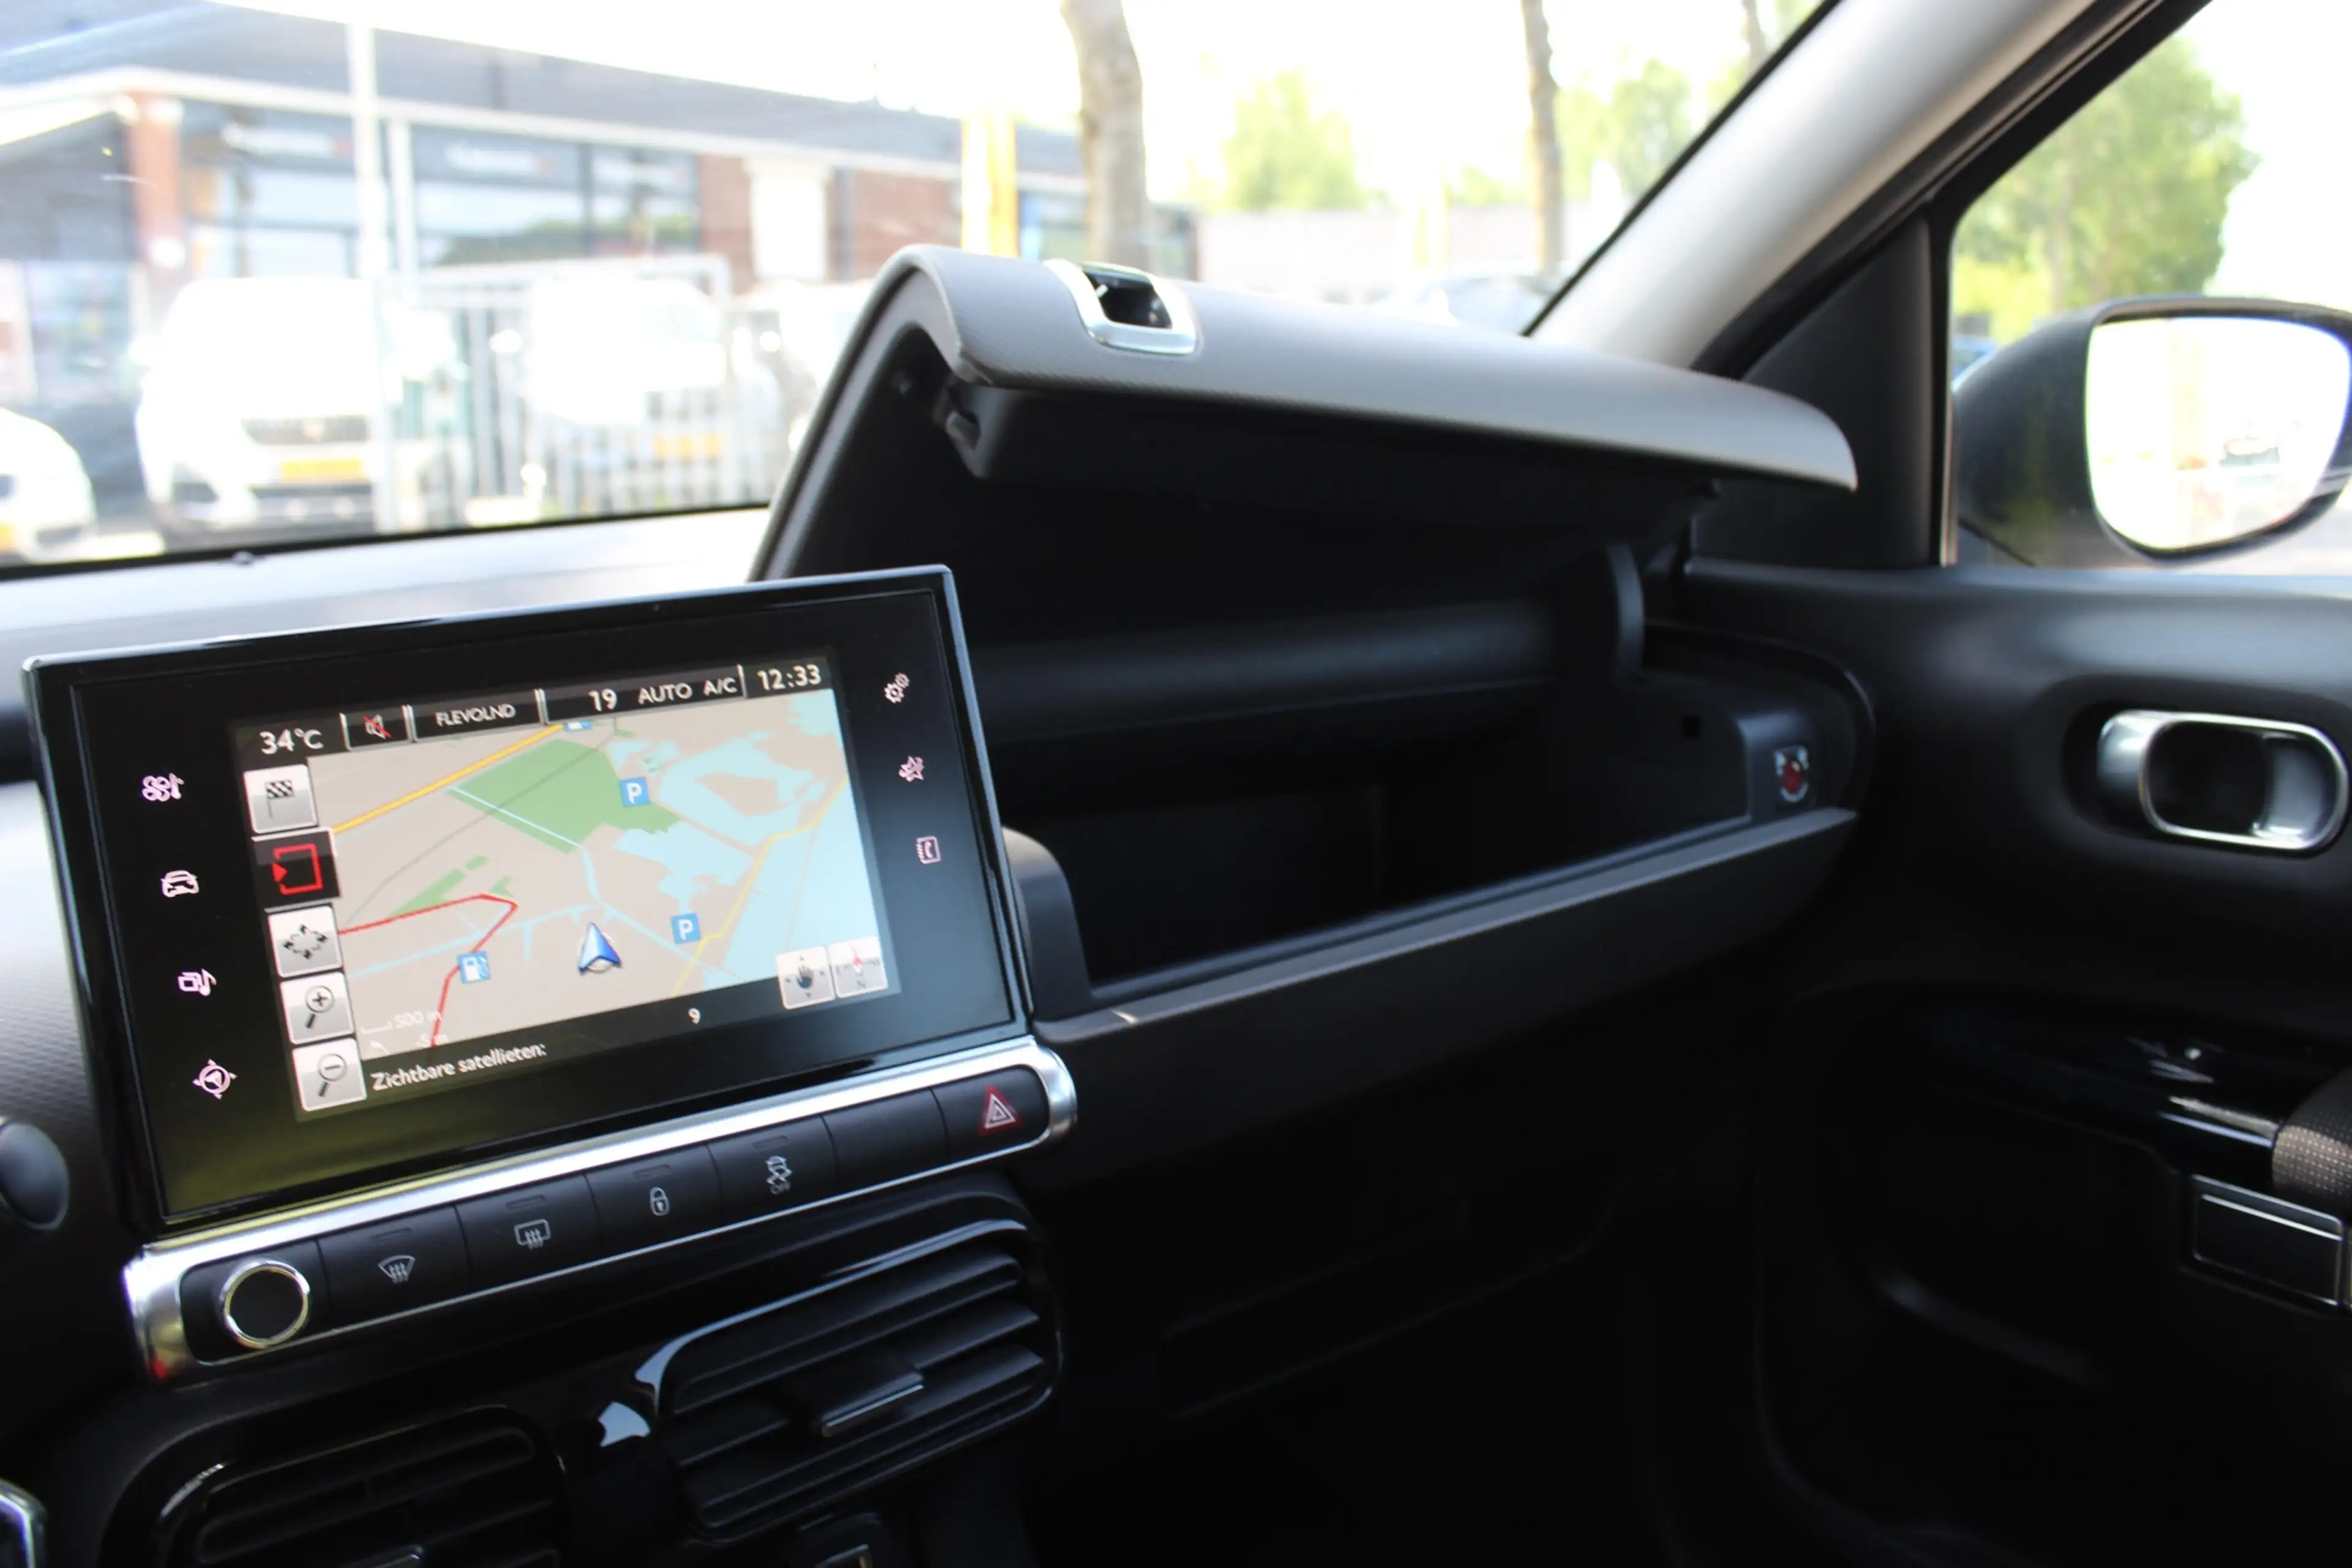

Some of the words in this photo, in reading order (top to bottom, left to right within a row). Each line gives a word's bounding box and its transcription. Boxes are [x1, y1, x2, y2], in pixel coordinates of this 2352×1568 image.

[757, 664, 822, 692] 12:33
[589, 688, 617, 712] 19
[638, 682, 693, 705] AUTO
[703, 676, 738, 697] A/C
[435, 703, 516, 727] FLEVOLND
[259, 728, 324, 755] 34°C
[625, 782, 643, 804] P
[677, 919, 694, 940] P
[394, 1010, 423, 1029] 500
[688, 1008, 701, 1025] 9
[370, 1062, 456, 1091] Zichtbare
[458, 1043, 548, 1072] satellieten:
